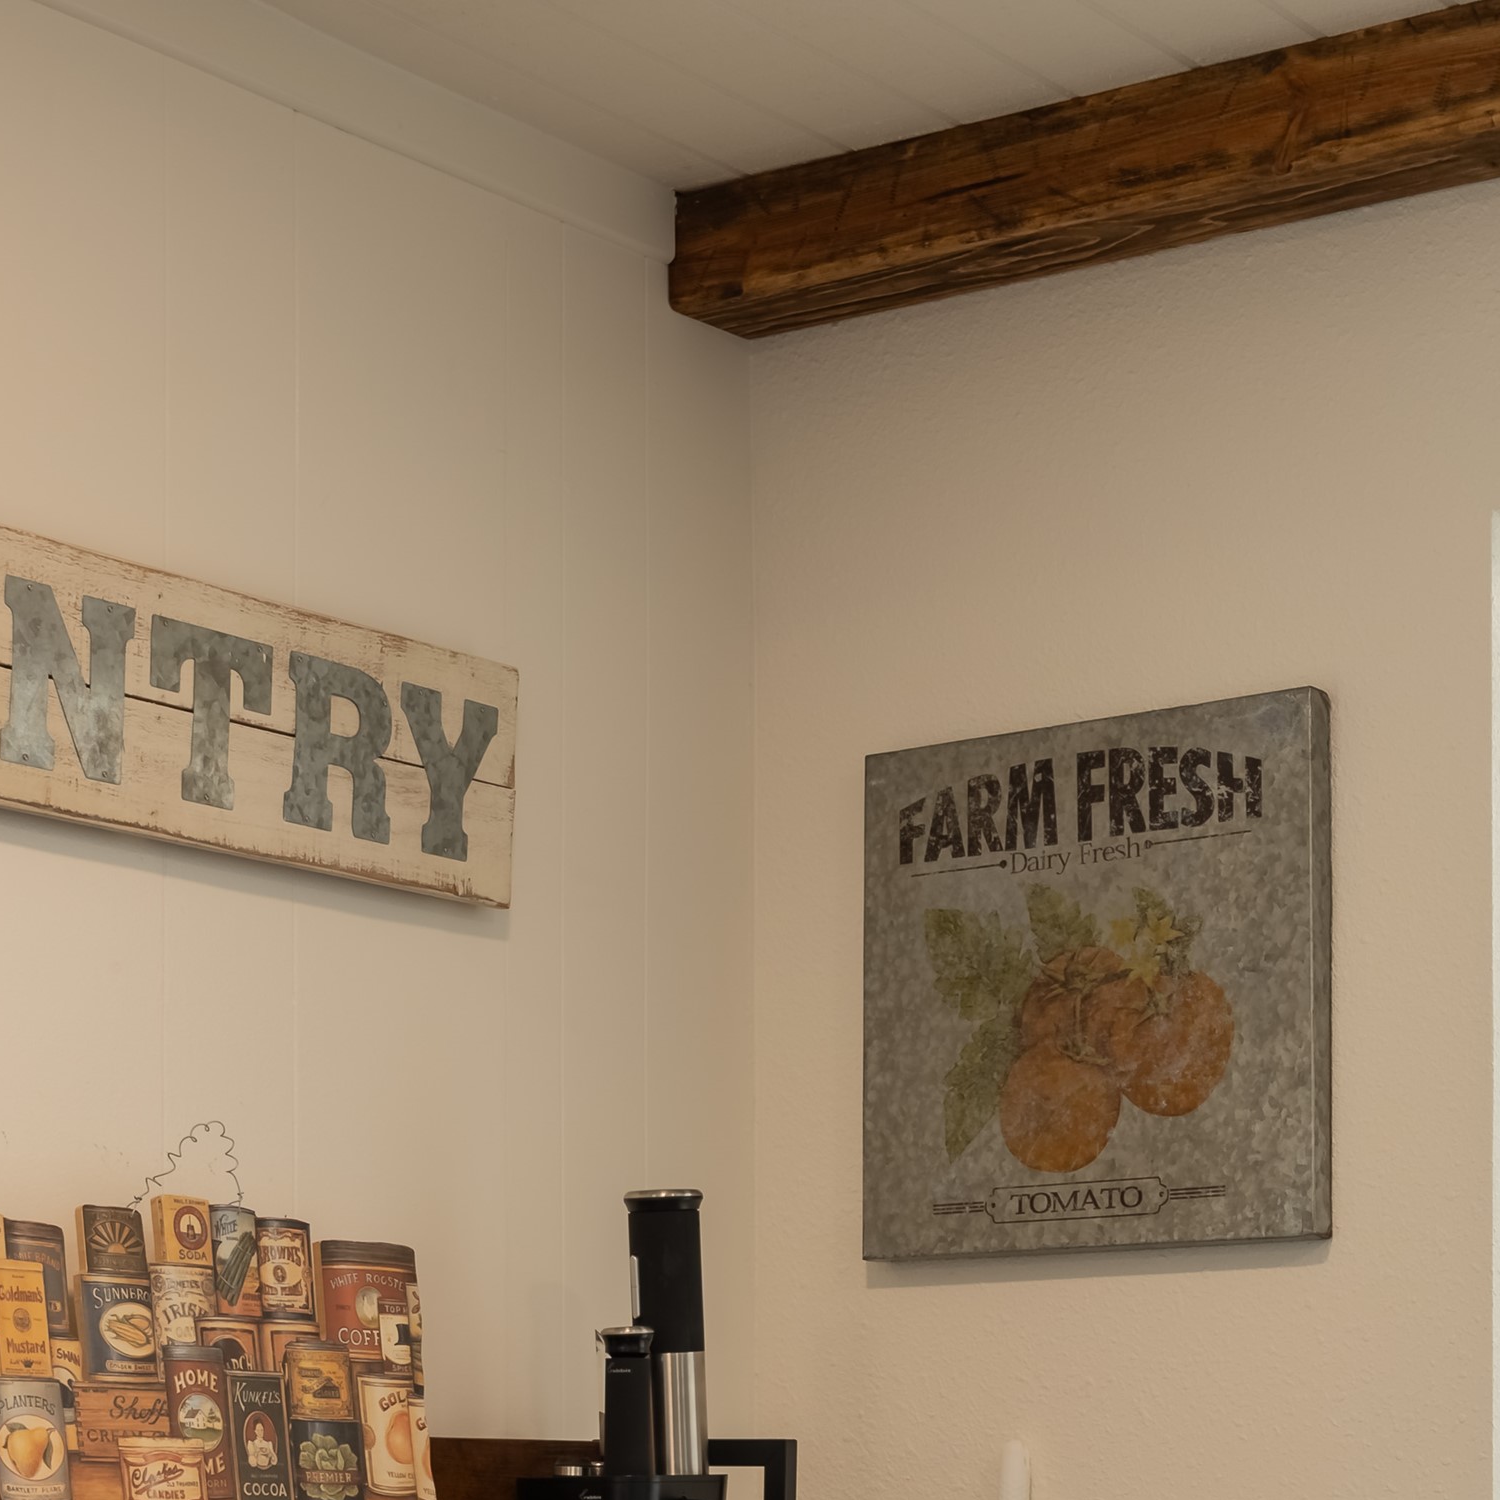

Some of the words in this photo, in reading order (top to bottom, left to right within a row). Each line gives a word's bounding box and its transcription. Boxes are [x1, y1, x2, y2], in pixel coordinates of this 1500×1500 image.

[898, 757, 1058, 865] FARM
[1075, 745, 1264, 842] FRESH
[1009, 846, 1071, 880] Dairy
[1079, 838, 1143, 867] Fresh
[1009, 1185, 1144, 1217] TOMATO
[214, 1214, 238, 1239] WHITE
[179, 1249, 208, 1262] SODA
[330, 1273, 359, 1289] WHITE
[366, 1273, 404, 1291] ROOSTE
[93, 1287, 149, 1310] SUNNBRO
[162, 1301, 209, 1324] IRISH
[384, 1304, 401, 1314] TOP
[338, 1327, 380, 1346] COFF
[6, 1338, 46, 1354] Mustard
[56, 1348, 81, 1367] SWAN
[391, 1363, 412, 1372] SPIC
[173, 1369, 219, 1394] HOME
[234, 1381, 281, 1412] KUNKEL'S
[378, 1391, 407, 1412] GOL
[416, 1416, 427, 1431] G
[204, 1452, 226, 1476] ME
[207, 1479, 227, 1488] ORN
[305, 1470, 352, 1483] PREMIER
[387, 1470, 407, 1479] YELLOW
[6, 1485, 39, 1493] BARTLETT
[147, 1489, 186, 1500] CANDIES
[243, 1482, 288, 1497] COCOA
[423, 1487, 436, 1495] YELL
